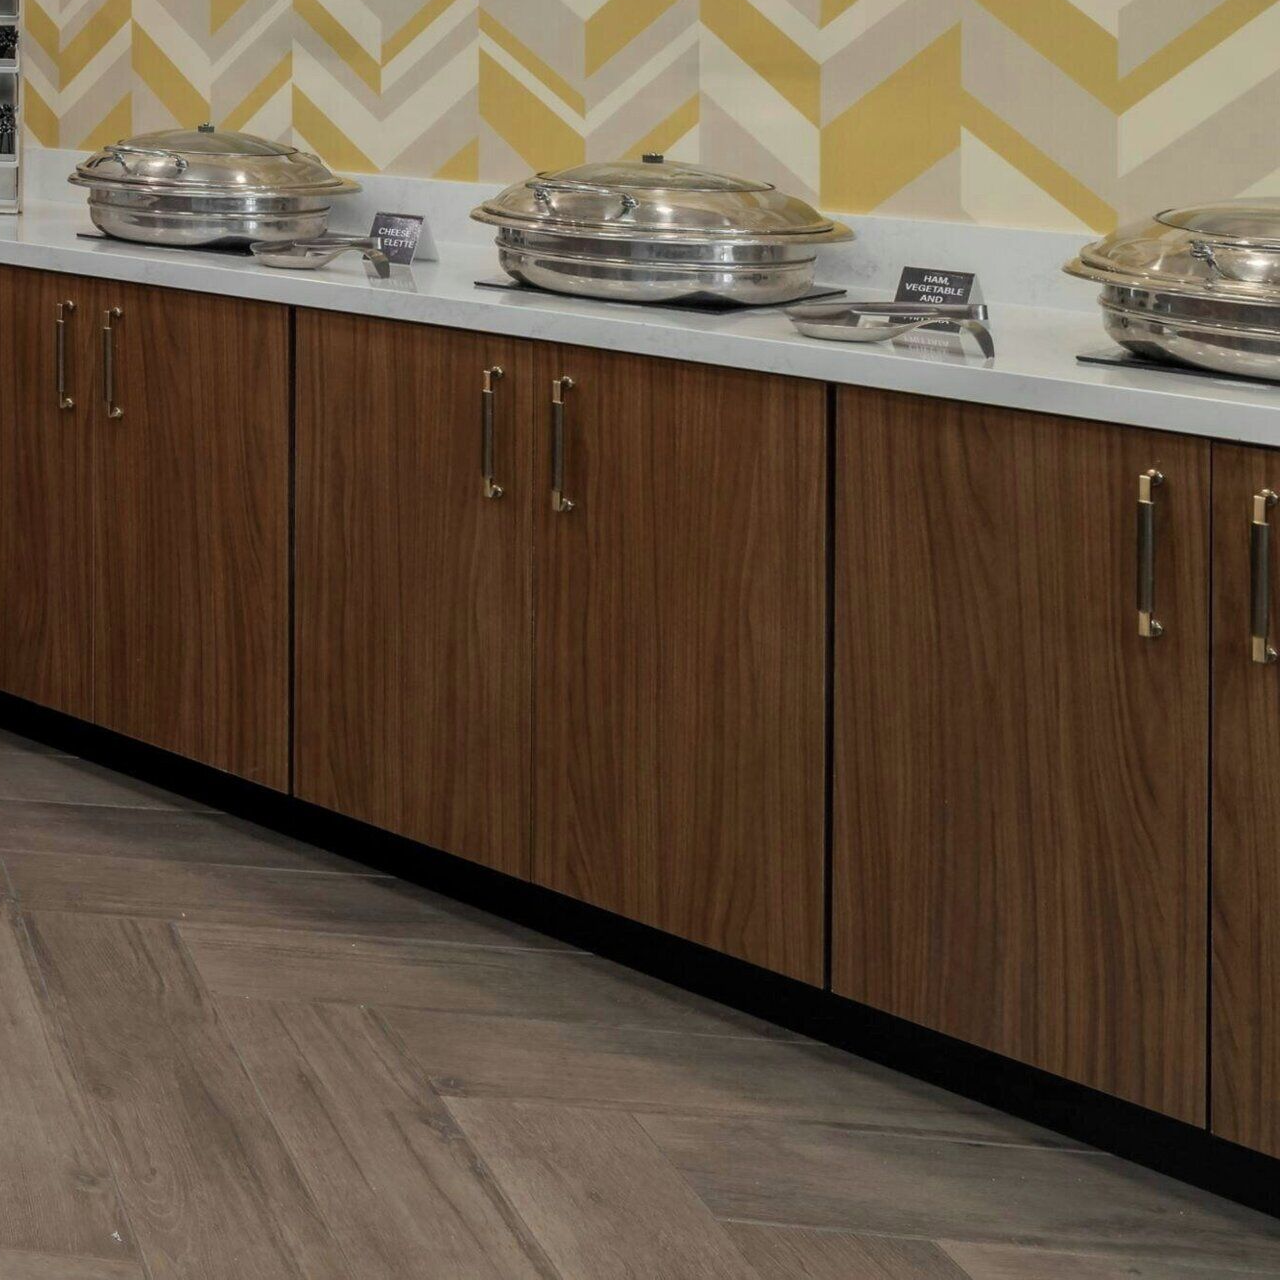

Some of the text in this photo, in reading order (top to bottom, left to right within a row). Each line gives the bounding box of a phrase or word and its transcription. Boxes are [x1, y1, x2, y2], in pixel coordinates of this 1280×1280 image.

[378, 227, 412, 238] CHEESE
[383, 238, 415, 249] ELETTE
[923, 274, 950, 286] HAM,
[905, 282, 965, 297] VEGETABLE
[919, 294, 944, 304] AND
